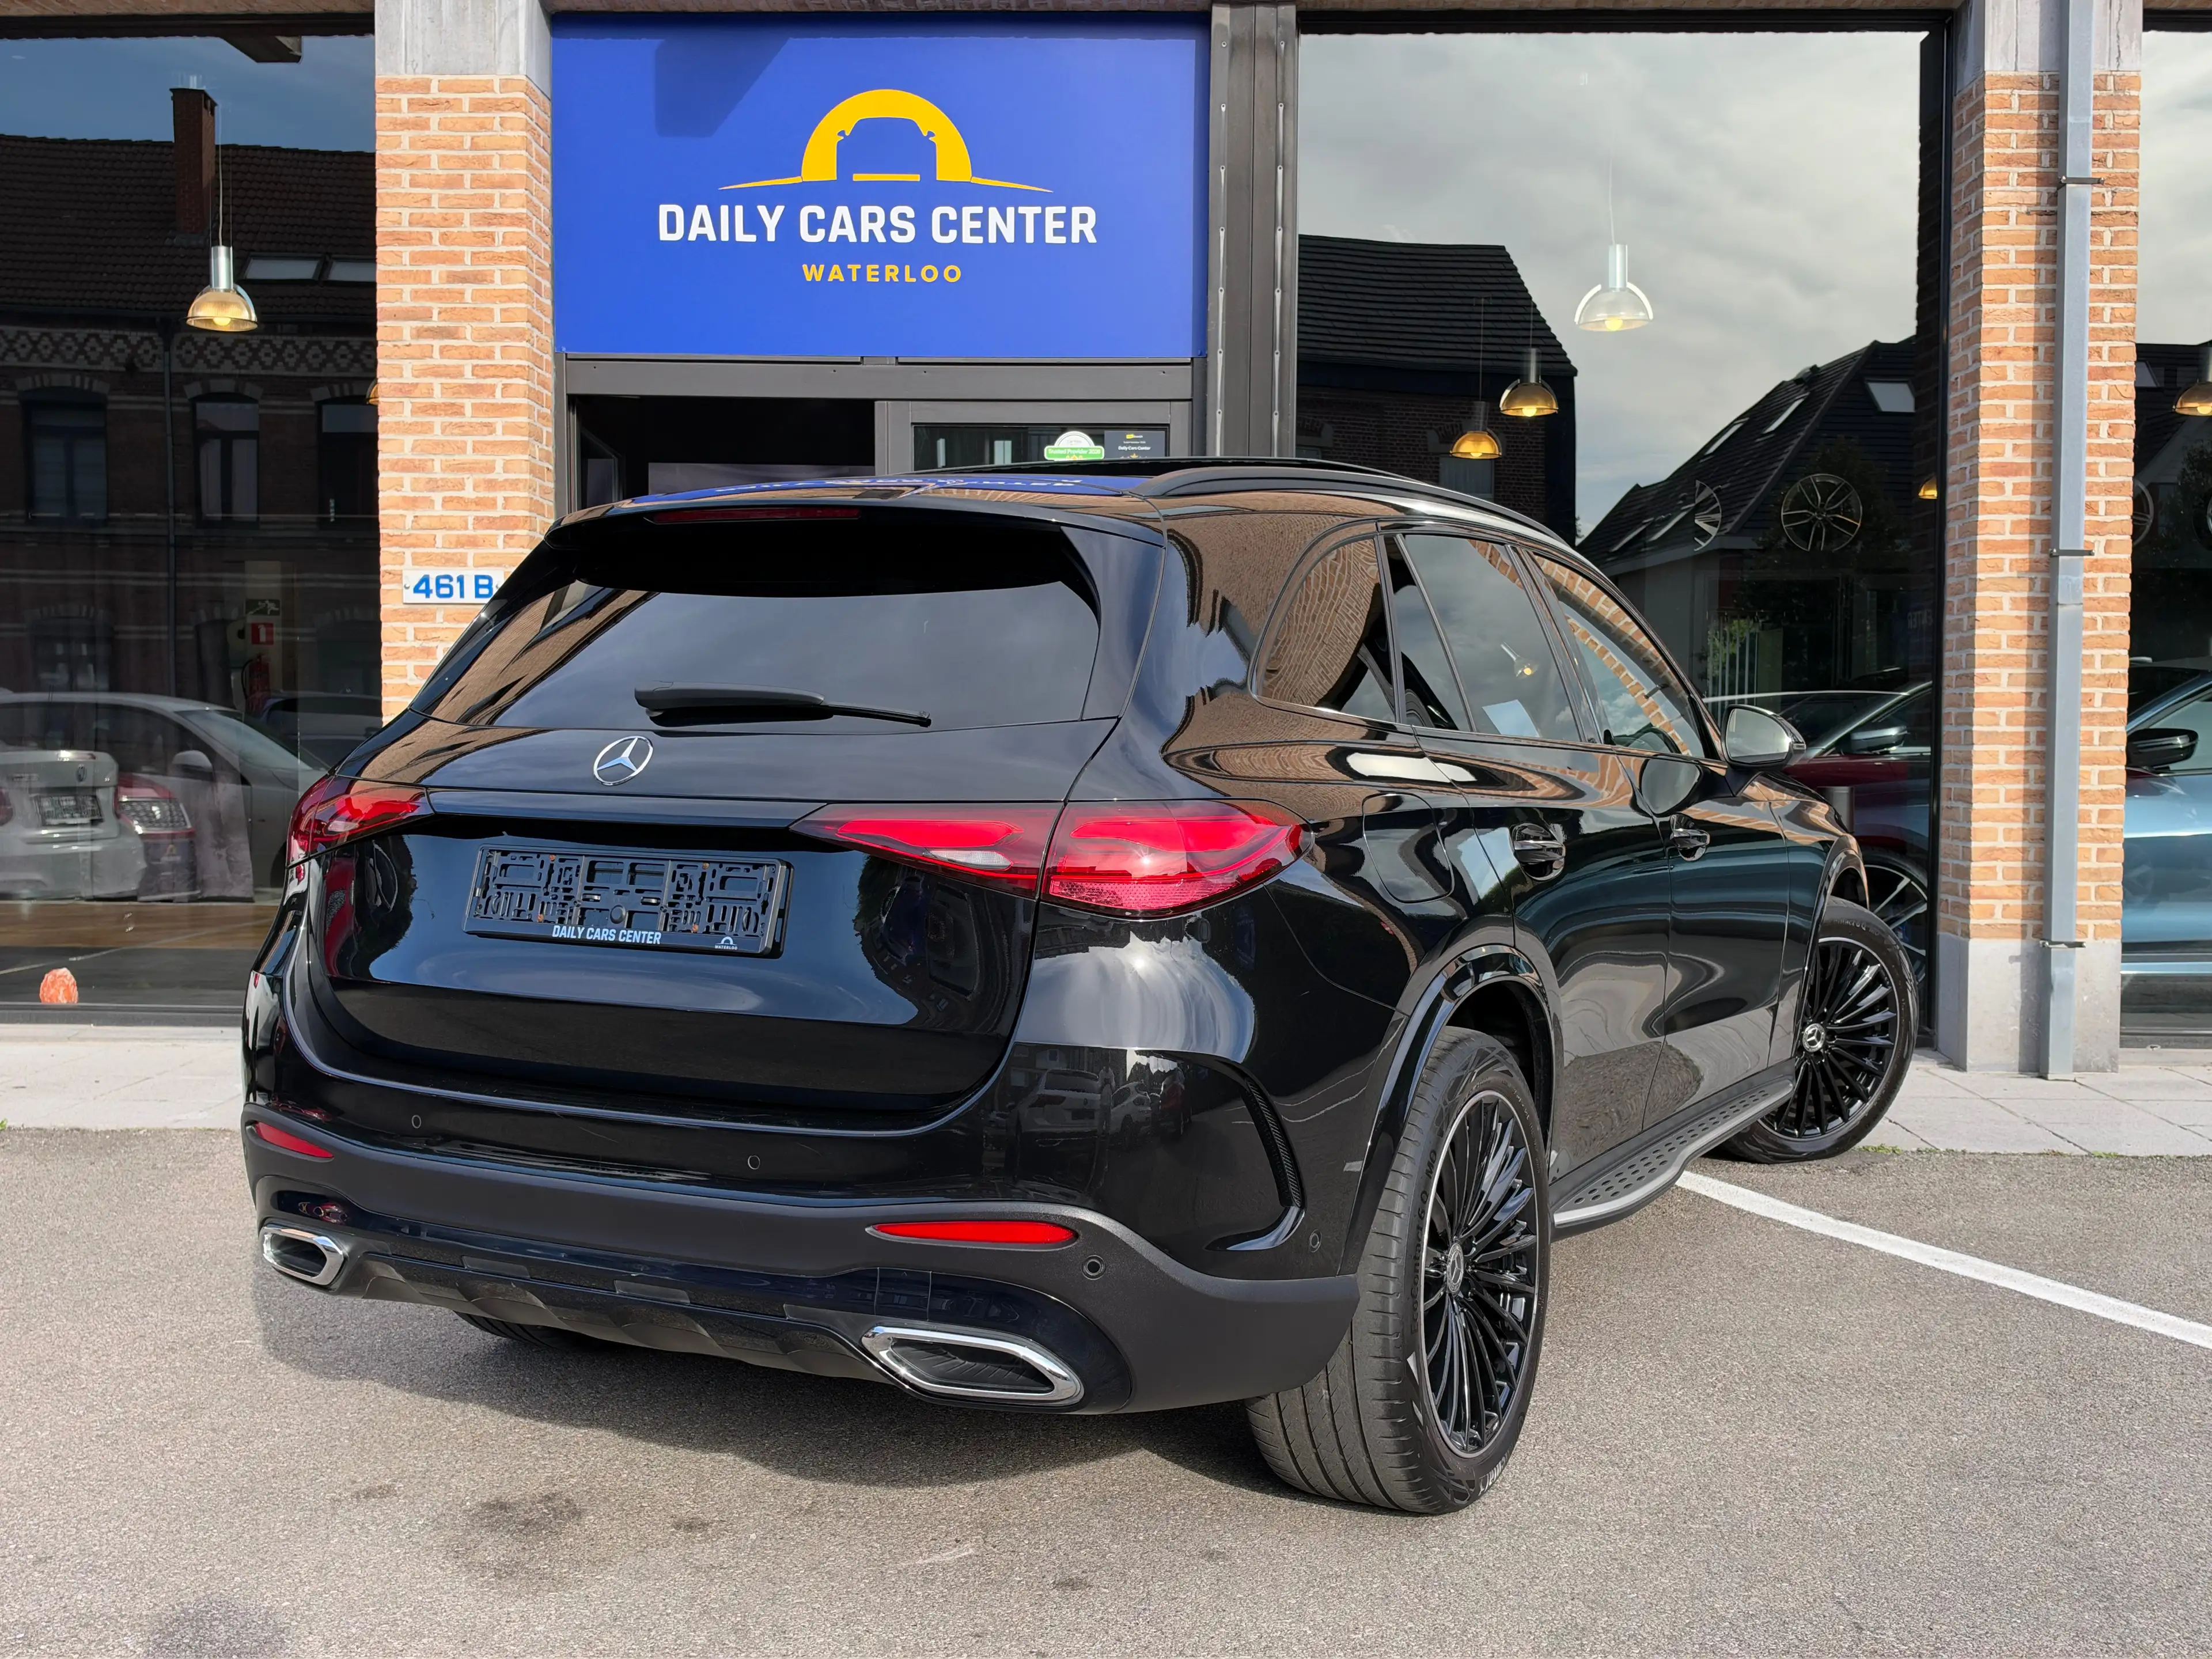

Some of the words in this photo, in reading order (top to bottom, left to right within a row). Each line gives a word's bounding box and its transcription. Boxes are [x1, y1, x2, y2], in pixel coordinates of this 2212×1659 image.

[658, 203, 785, 242] DAILY
[799, 204, 916, 243] CARS
[931, 206, 1097, 244] CENTER
[802, 264, 961, 282] WATERLOO
[412, 574, 465, 599] 461
[474, 574, 494, 599] B
[551, 925, 585, 939] DAILY
[586, 927, 616, 942] CARS
[618, 929, 662, 945] CENTER
[1411, 1224, 1424, 1334] EcoContact
[1421, 1190, 1429, 1204] Q
[1425, 1149, 1437, 1179] MO
